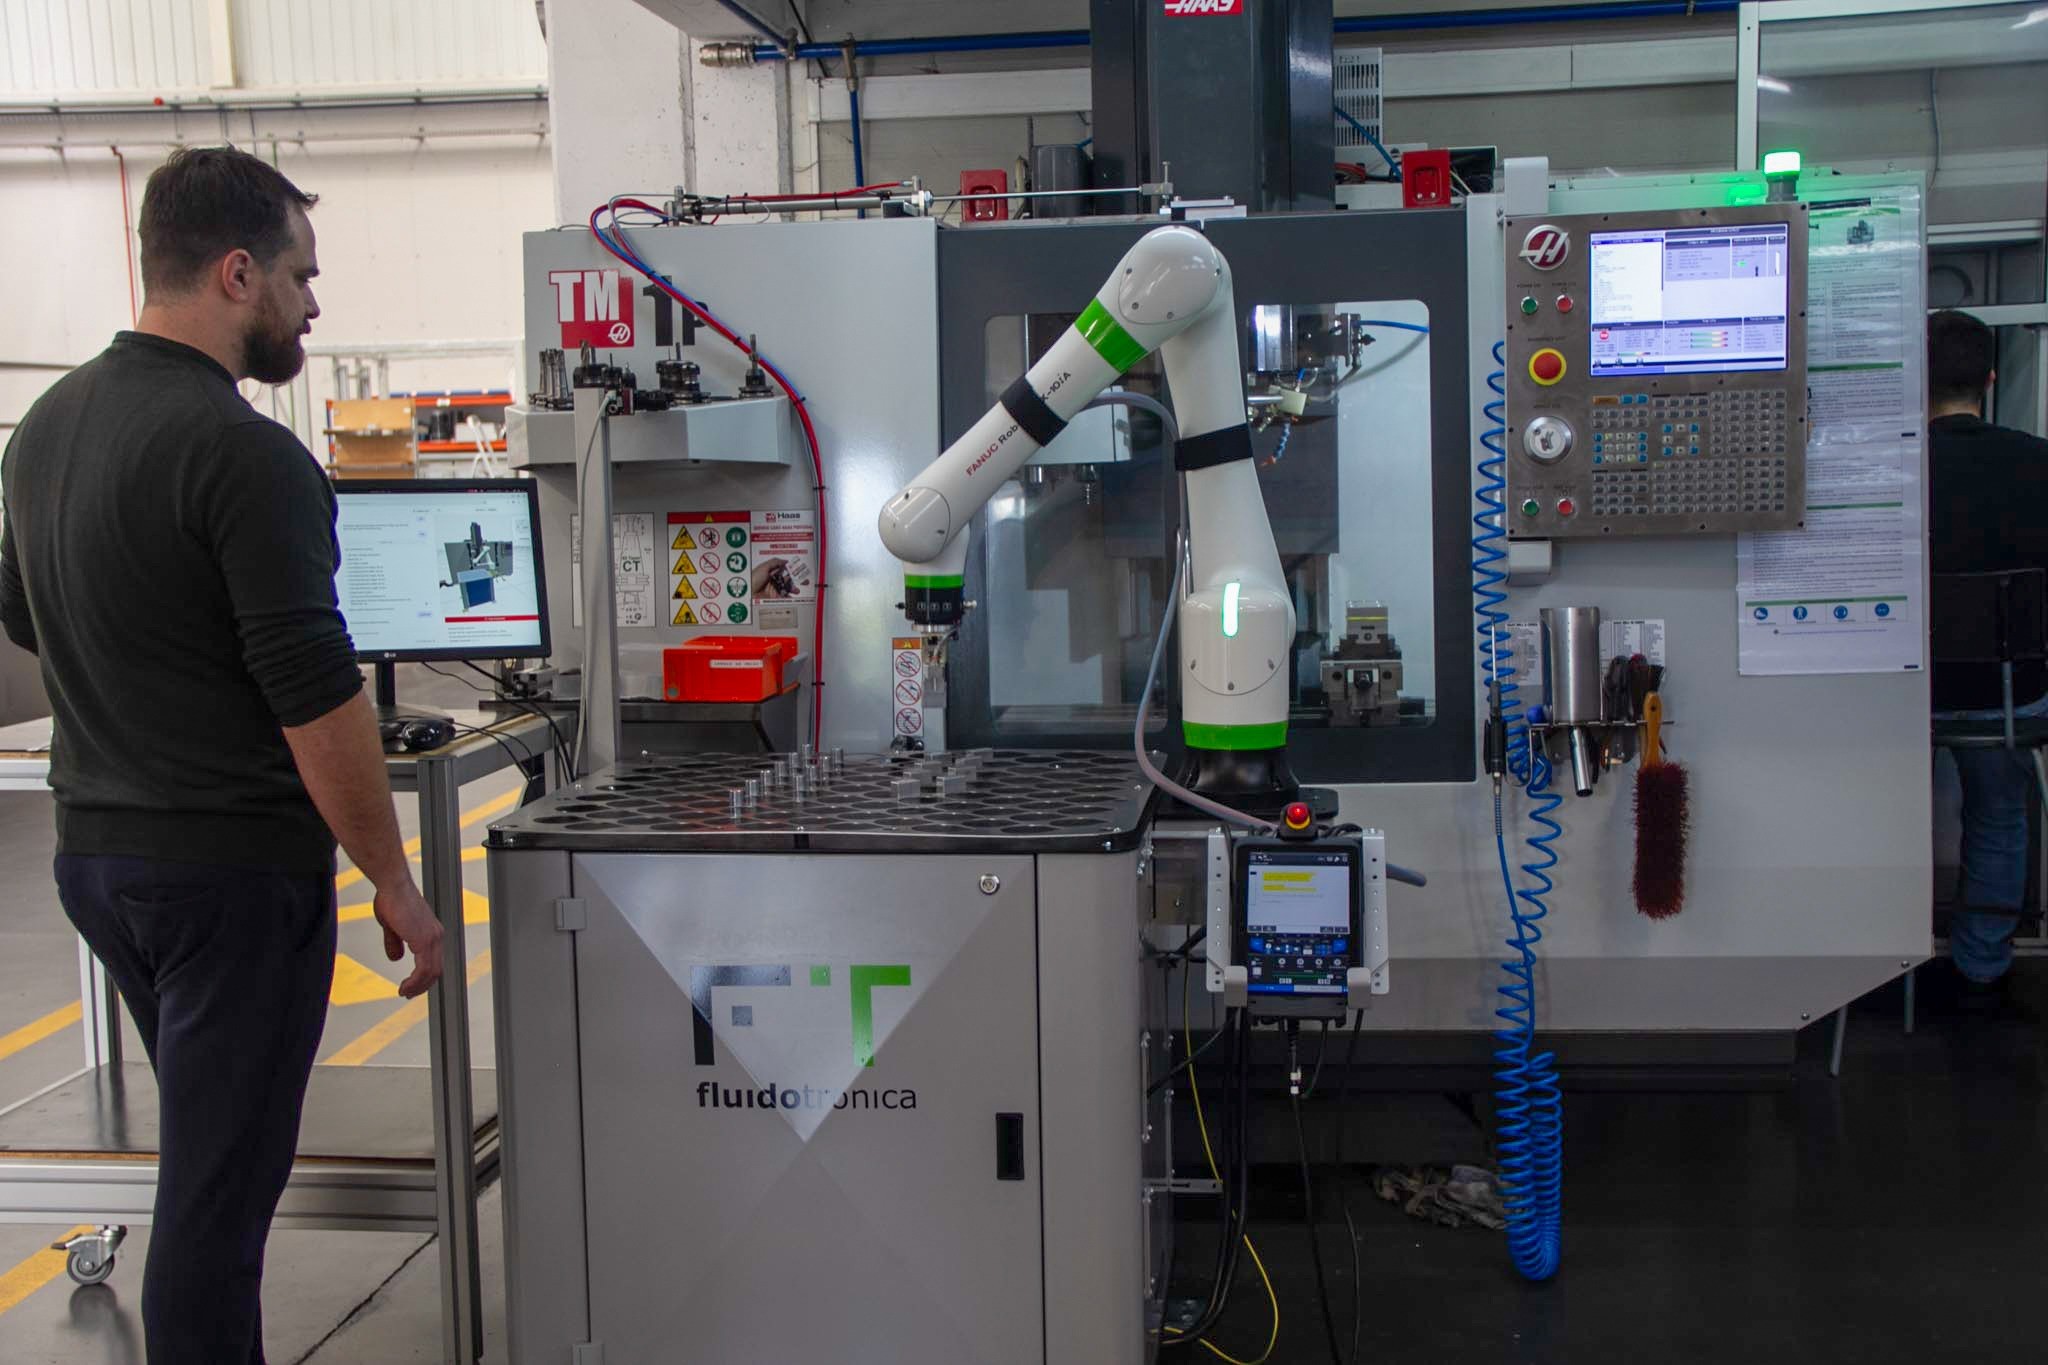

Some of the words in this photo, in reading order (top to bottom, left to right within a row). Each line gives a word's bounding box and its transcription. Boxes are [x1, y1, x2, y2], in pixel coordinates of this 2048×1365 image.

[550, 271, 620, 322] TM
[966, 442, 999, 476] FANUC
[997, 423, 1019, 445] Rob
[622, 560, 641, 572] CT
[697, 1081, 917, 1109] fluidotronica
